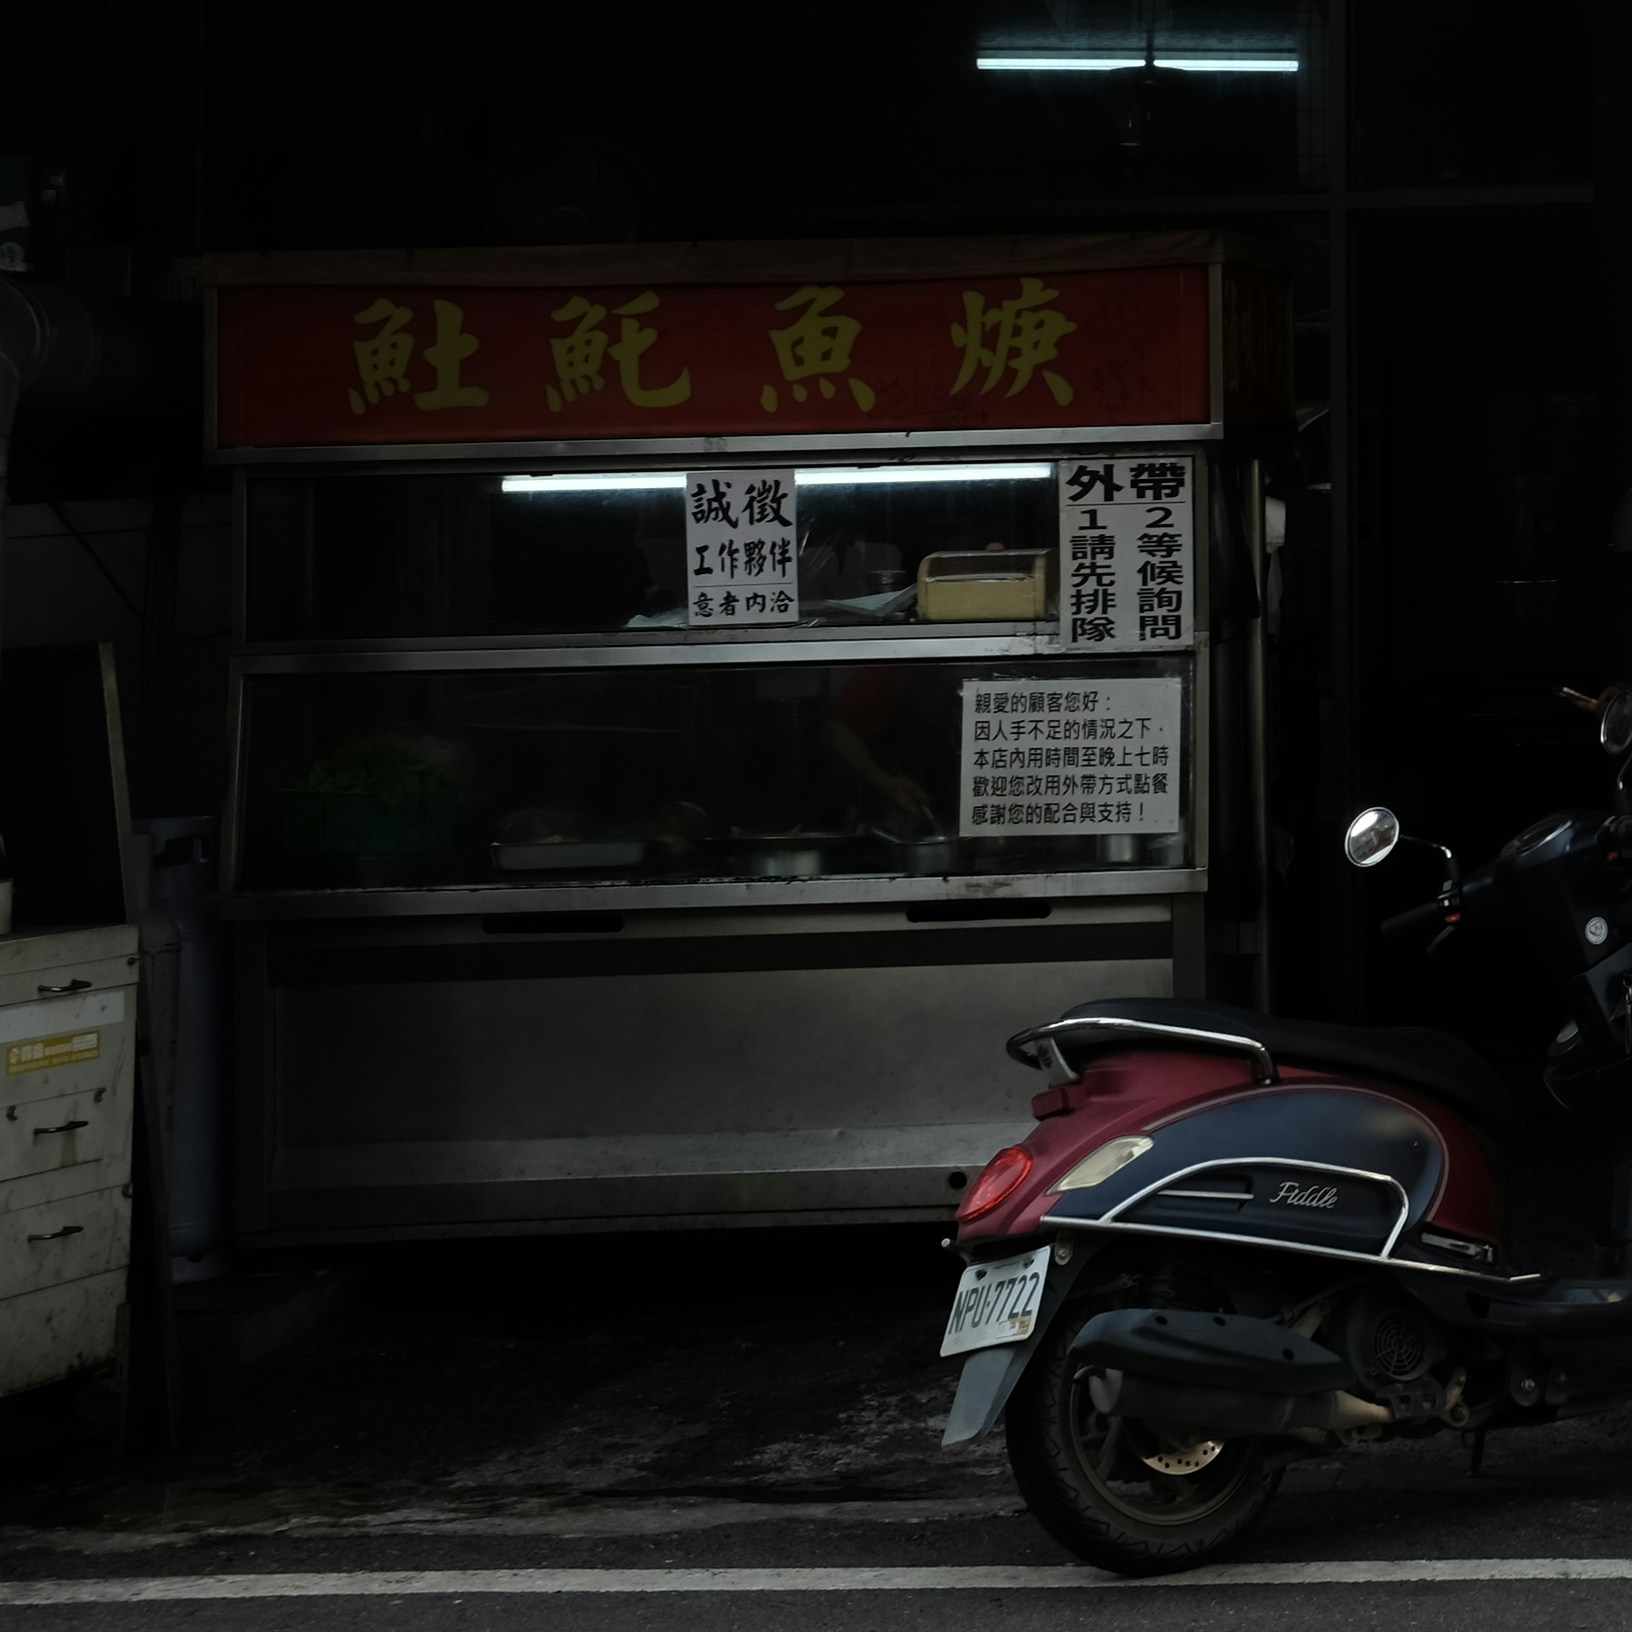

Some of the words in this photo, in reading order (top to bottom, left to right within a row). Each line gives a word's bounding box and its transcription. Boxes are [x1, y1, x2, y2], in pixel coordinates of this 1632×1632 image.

[690, 479, 794, 529] 誠徵
[1066, 462, 1186, 503] 外帶
[693, 537, 793, 580] 工作夥伴
[1070, 509, 1118, 643] 1請先排隊
[1136, 506, 1185, 642] 2等候詢問
[972, 773, 1169, 797] 歡迎您改用外帶方式點餐
[1269, 1181, 1338, 1210] Fiddle
[948, 1271, 1041, 1335] NPU-7722
